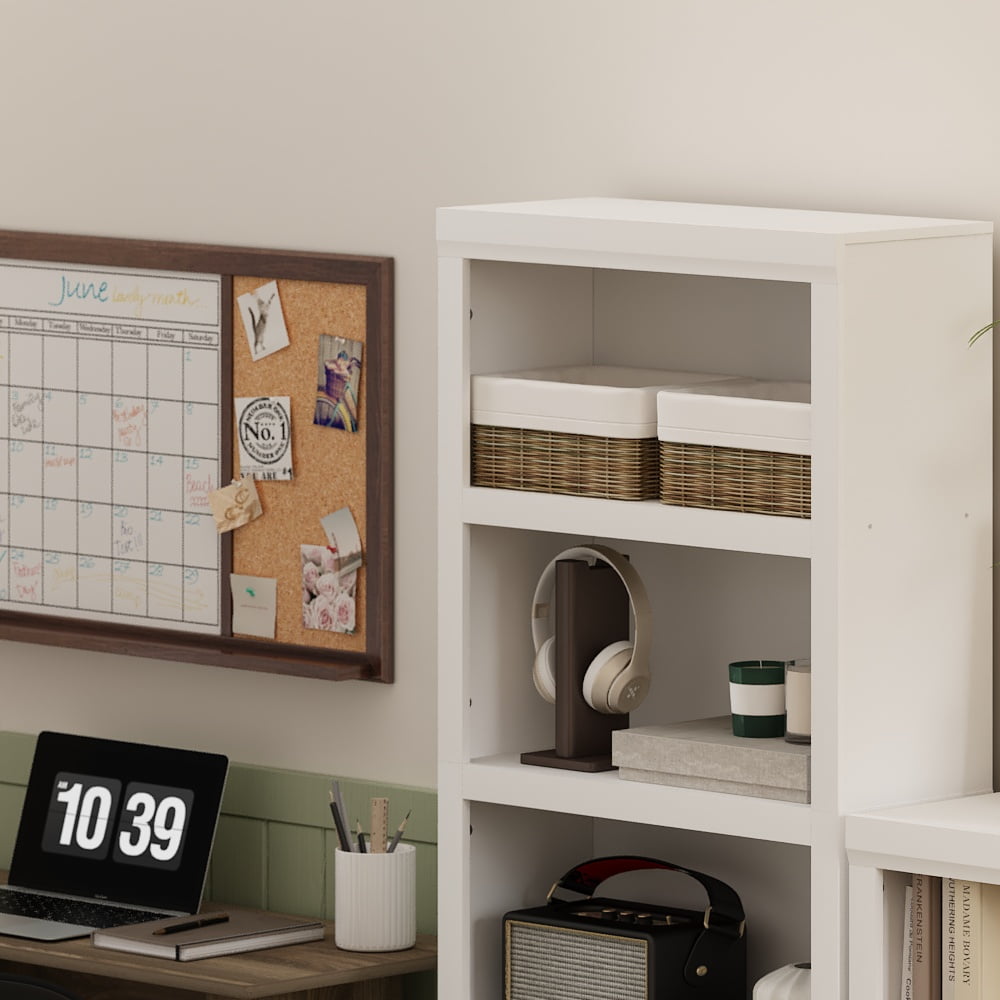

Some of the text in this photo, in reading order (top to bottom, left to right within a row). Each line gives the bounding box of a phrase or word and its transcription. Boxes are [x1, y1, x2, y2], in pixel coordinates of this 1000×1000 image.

[48, 275, 108, 306] June
[115, 325, 142, 336] Thursday
[157, 330, 175, 339] Friday
[243, 421, 287, 441] No. 1
[45, 444, 56, 456] 11
[80, 448, 93, 459] 12
[114, 452, 128, 463] 13
[150, 455, 163, 466] 14
[185, 458, 200, 469] 15
[80, 503, 93, 519] 19
[149, 509, 163, 521] 21
[185, 513, 200, 525] 22
[80, 556, 96, 568] 26
[114, 560, 130, 573] 27
[149, 564, 163, 576] 28
[184, 569, 199, 585] 29
[57, 782, 187, 861] 10 39
[962, 885, 970, 937] MADAME
[962, 941, 970, 986] BOVARY
